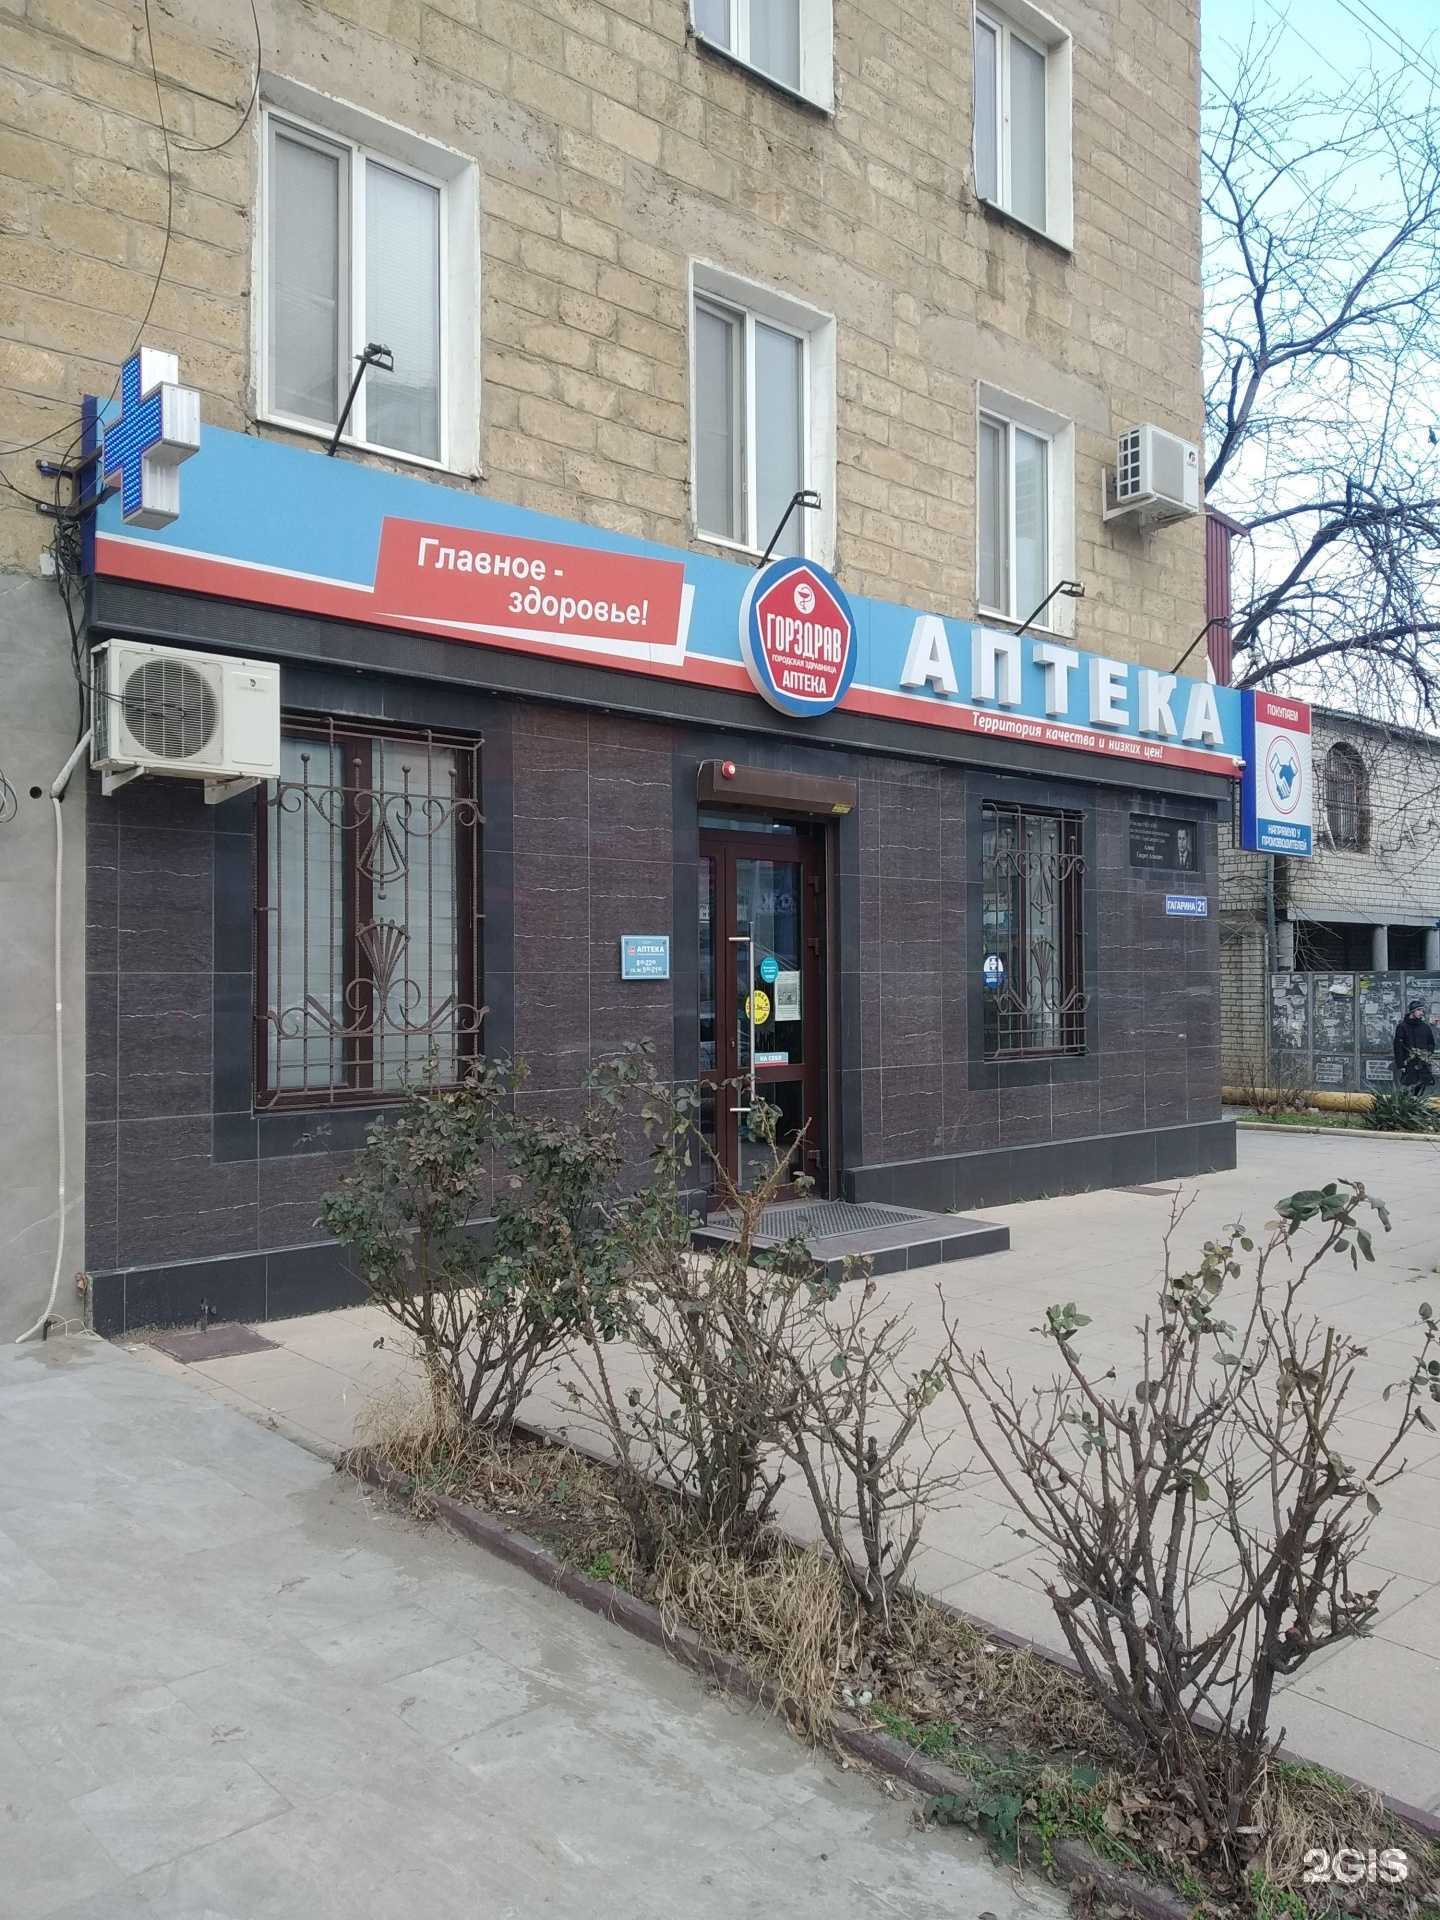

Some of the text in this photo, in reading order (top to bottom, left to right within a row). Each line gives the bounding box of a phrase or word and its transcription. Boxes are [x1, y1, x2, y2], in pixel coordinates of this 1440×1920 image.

[417, 537, 546, 581] Главное
[508, 585, 649, 625] здоровье!
[766, 613, 842, 663] ГОРЗДРАВ
[782, 670, 827, 694] АПТЕКА
[900, 614, 1225, 746] АПТЕКА
[1267, 703, 1299, 722] ПОКУПАЕМ
[972, 711, 1164, 760] Территория качества и низких цен!
[1167, 899, 1205, 912] ГАГАРИНА 21
[636, 945, 665, 953] АПТЕКА
